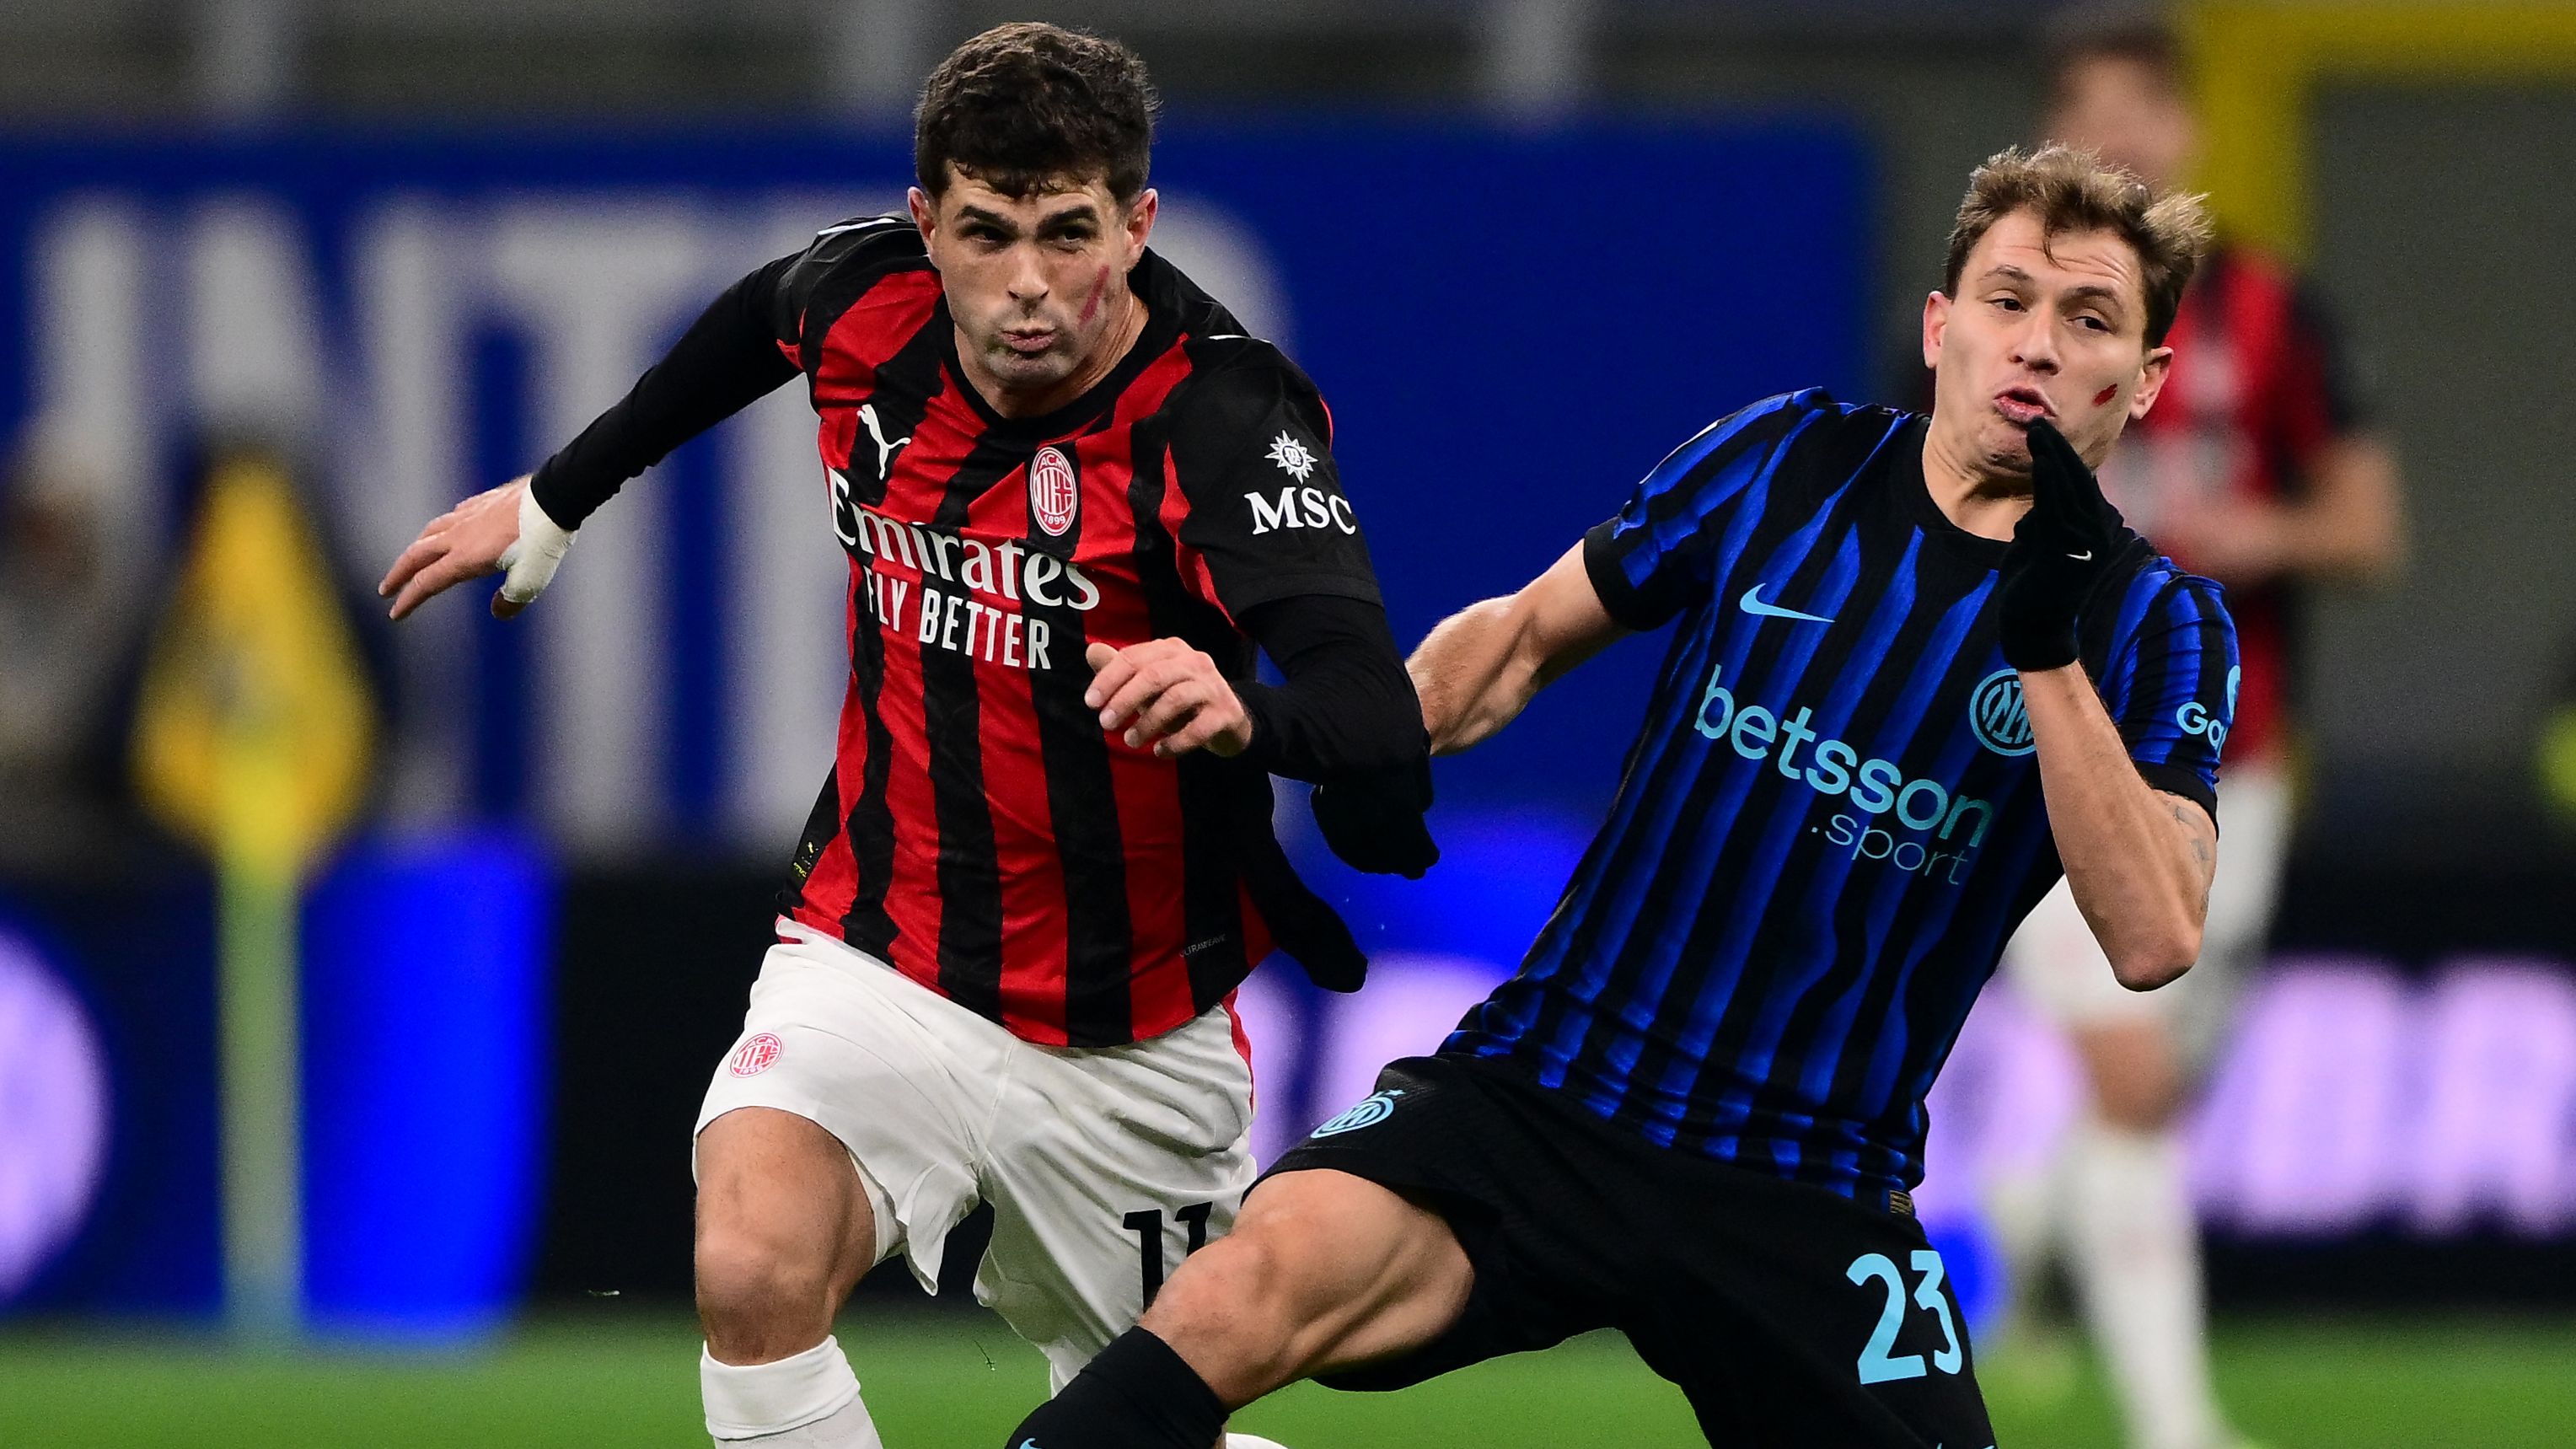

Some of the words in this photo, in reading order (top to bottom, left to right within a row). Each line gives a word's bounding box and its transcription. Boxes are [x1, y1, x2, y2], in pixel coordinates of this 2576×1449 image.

[824, 465, 1099, 610] Emirates
[1044, 513, 1066, 525] 1899
[1244, 486, 1356, 535] MSC
[863, 565, 908, 632] FLY
[918, 588, 1051, 669] BETTER
[1694, 663, 1994, 840] betsson
[1845, 1249, 1962, 1385] 23
